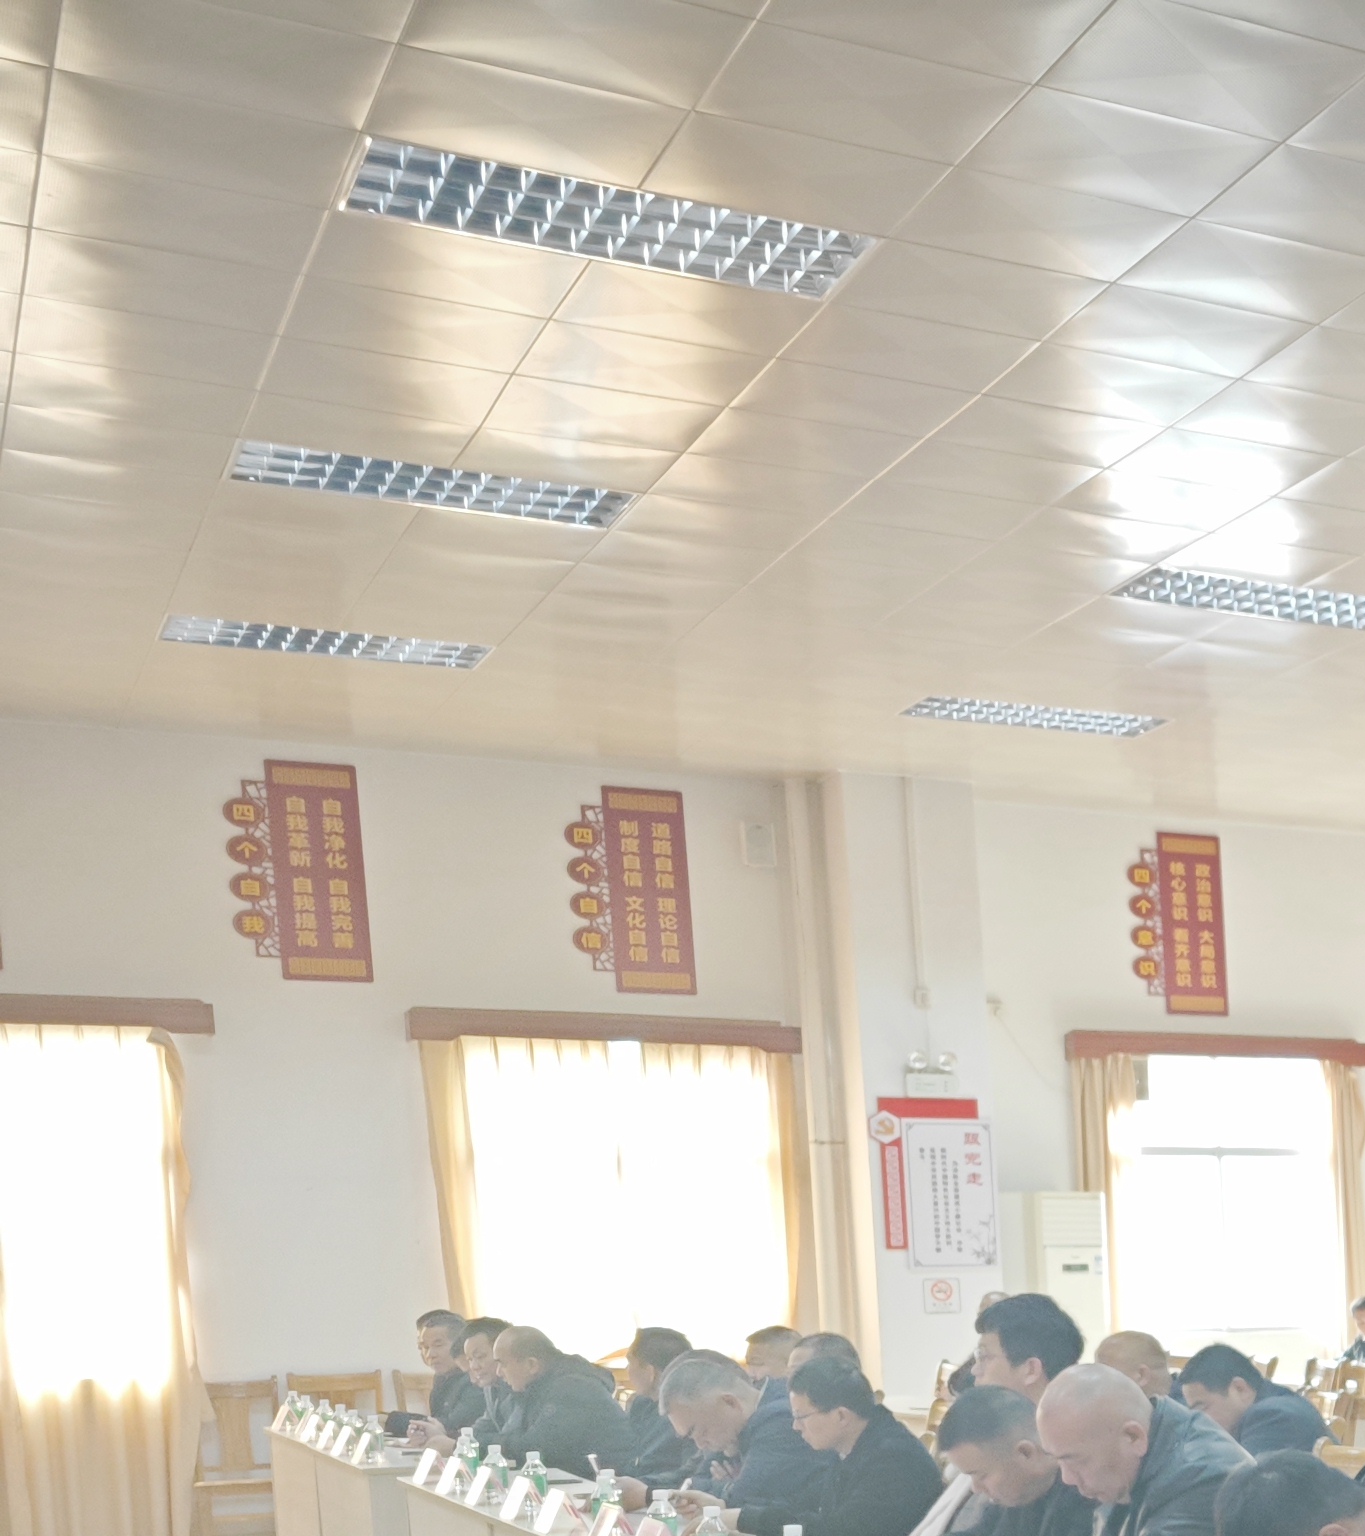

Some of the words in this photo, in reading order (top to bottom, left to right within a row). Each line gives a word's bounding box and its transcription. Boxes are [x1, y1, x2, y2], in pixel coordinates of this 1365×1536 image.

[322, 798, 348, 869] 自我净化
[619, 820, 643, 888] 制度自信
[652, 822, 675, 889] 道路自信
[233, 803, 265, 934] 四个自我
[573, 827, 602, 949] 四个自信
[625, 895, 649, 963] 文化自信
[658, 897, 680, 964] 理论自信
[1133, 867, 1156, 976] 四个意识
